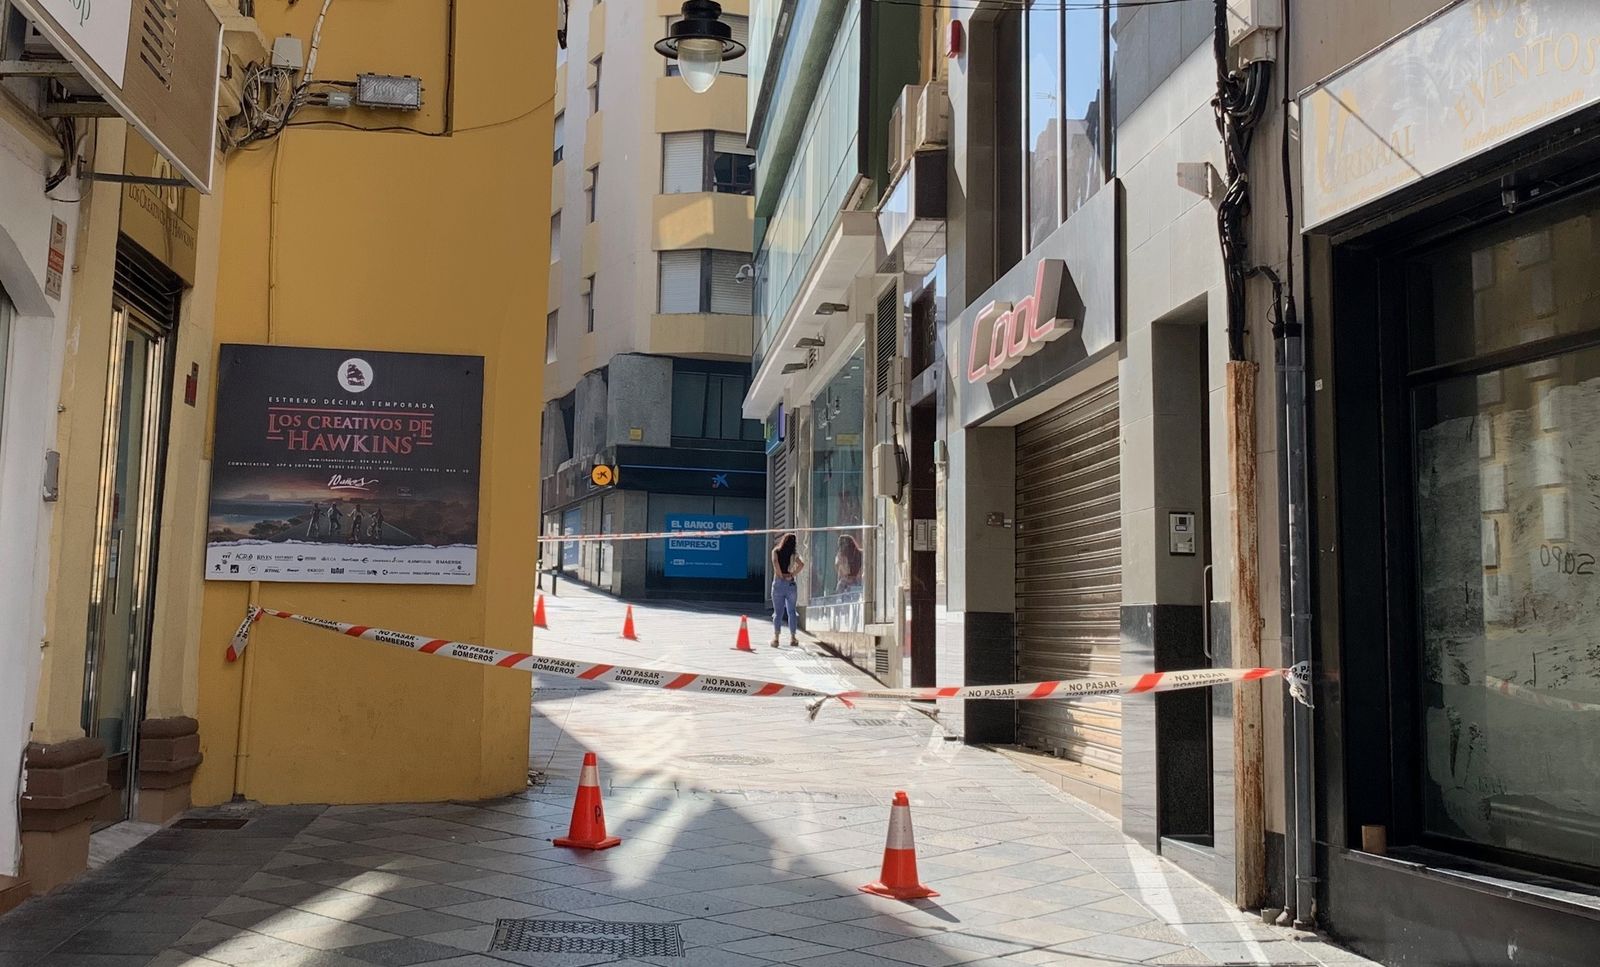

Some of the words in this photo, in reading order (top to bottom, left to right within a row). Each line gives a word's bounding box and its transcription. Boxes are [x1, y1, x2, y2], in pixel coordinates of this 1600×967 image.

[268, 396, 317, 405] ESTRENO
[324, 397, 364, 407] DÉCIMA
[371, 400, 435, 409] TEMPORADA
[268, 413, 302, 433] LOS
[307, 415, 402, 432] CREATIVOS
[409, 419, 433, 438] DE
[287, 430, 413, 455] HAWKINS
[671, 520, 681, 528] EL
[684, 521, 714, 529] BANCO
[716, 522, 734, 530] QUE
[670, 540, 718, 549] EMPRESAS
[378, 629, 390, 637] NO
[390, 631, 415, 641] PASAR
[375, 635, 415, 648] BOMBEROS
[452, 649, 494, 663] BOMBEROS
[470, 646, 495, 656] PASAR
[532, 663, 576, 675] BOMBEROS
[550, 659, 576, 669] PASAR
[615, 675, 660, 686] BOMBEROS
[633, 670, 660, 680] PASAR
[1174, 674, 1189, 682] NO
[1192, 671, 1226, 680] PASAR
[705, 677, 718, 686] NO
[719, 678, 747, 688] PASAR
[1069, 683, 1083, 692] NO
[1085, 680, 1118, 690] PASAR
[701, 684, 748, 695] BOMBEROS
[968, 689, 982, 697] NO
[984, 688, 1014, 697] PASAR
